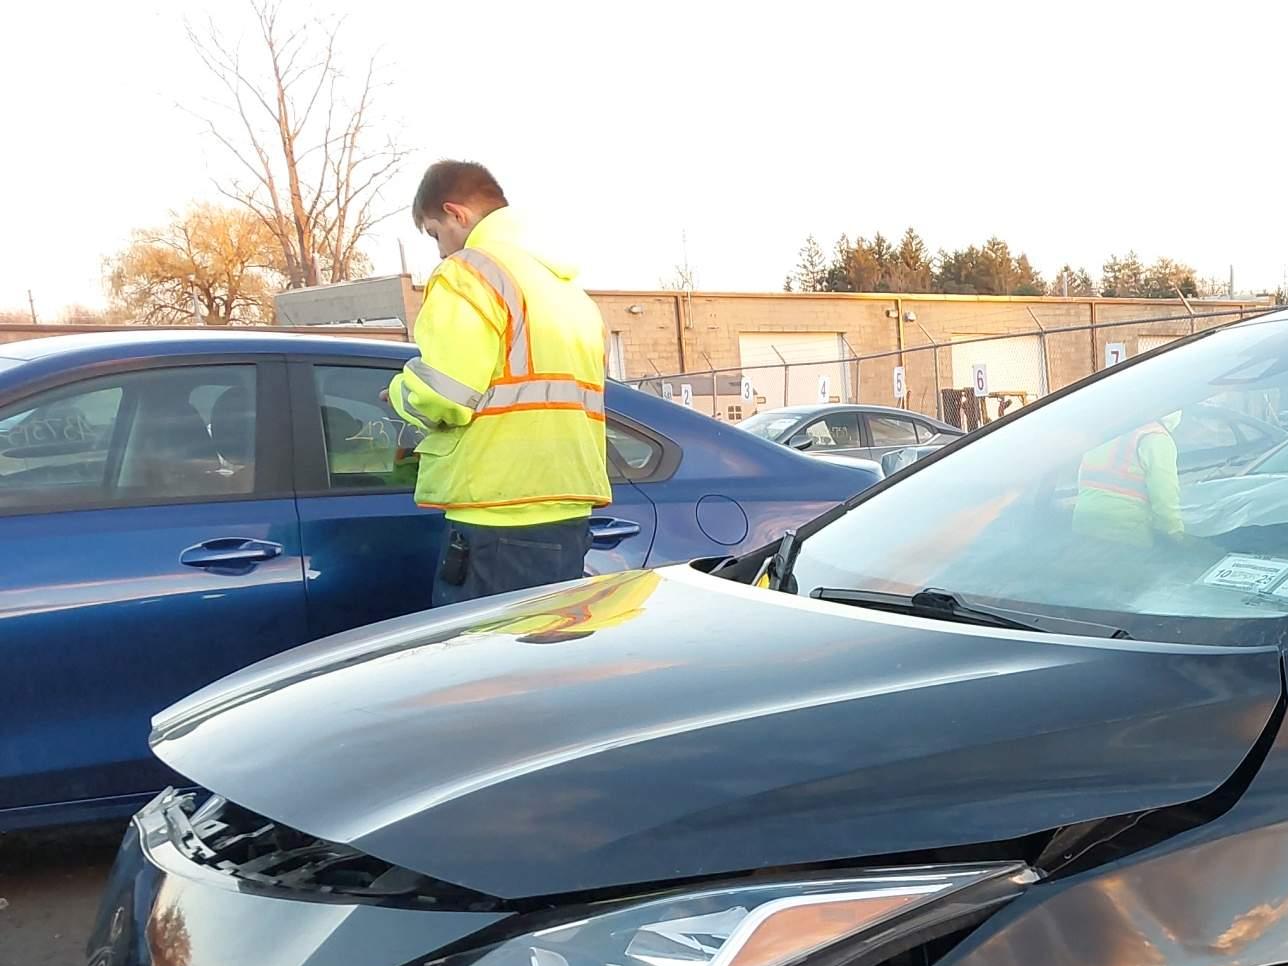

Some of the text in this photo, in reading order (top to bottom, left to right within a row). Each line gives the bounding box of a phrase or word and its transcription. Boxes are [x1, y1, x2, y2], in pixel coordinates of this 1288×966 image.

[820, 380, 827, 398] 4
[896, 372, 903, 393] 5
[976, 369, 985, 391] 6
[684, 389, 691, 405] 2
[743, 382, 751, 399] 3
